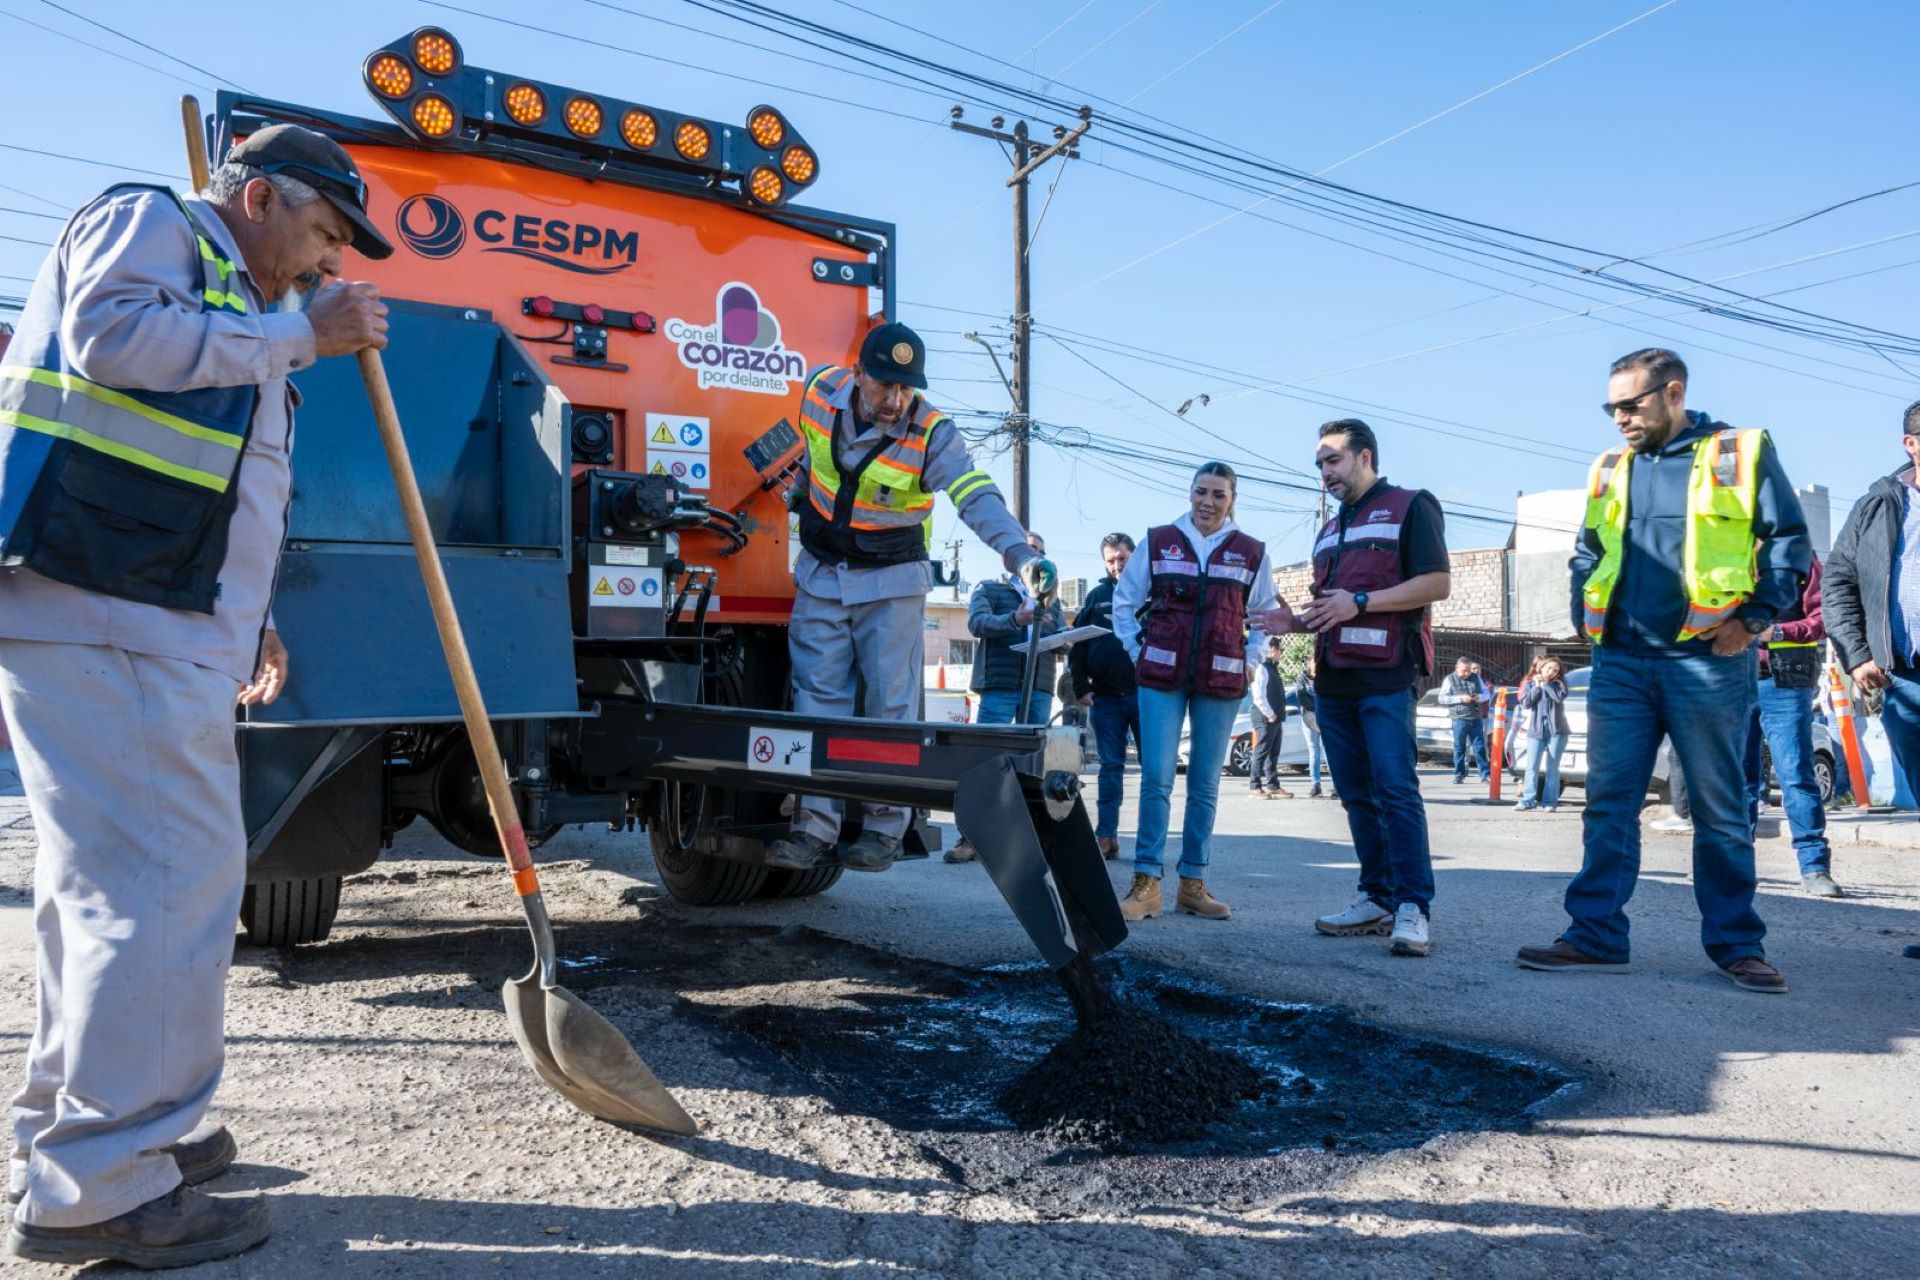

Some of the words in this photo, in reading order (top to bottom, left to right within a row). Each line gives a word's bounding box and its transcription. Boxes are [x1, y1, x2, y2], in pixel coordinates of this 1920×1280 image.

[474, 210, 638, 263] CESPM
[669, 323, 702, 340] Con
[704, 329, 717, 342] el
[684, 342, 803, 377] corazón
[703, 370, 728, 385] por
